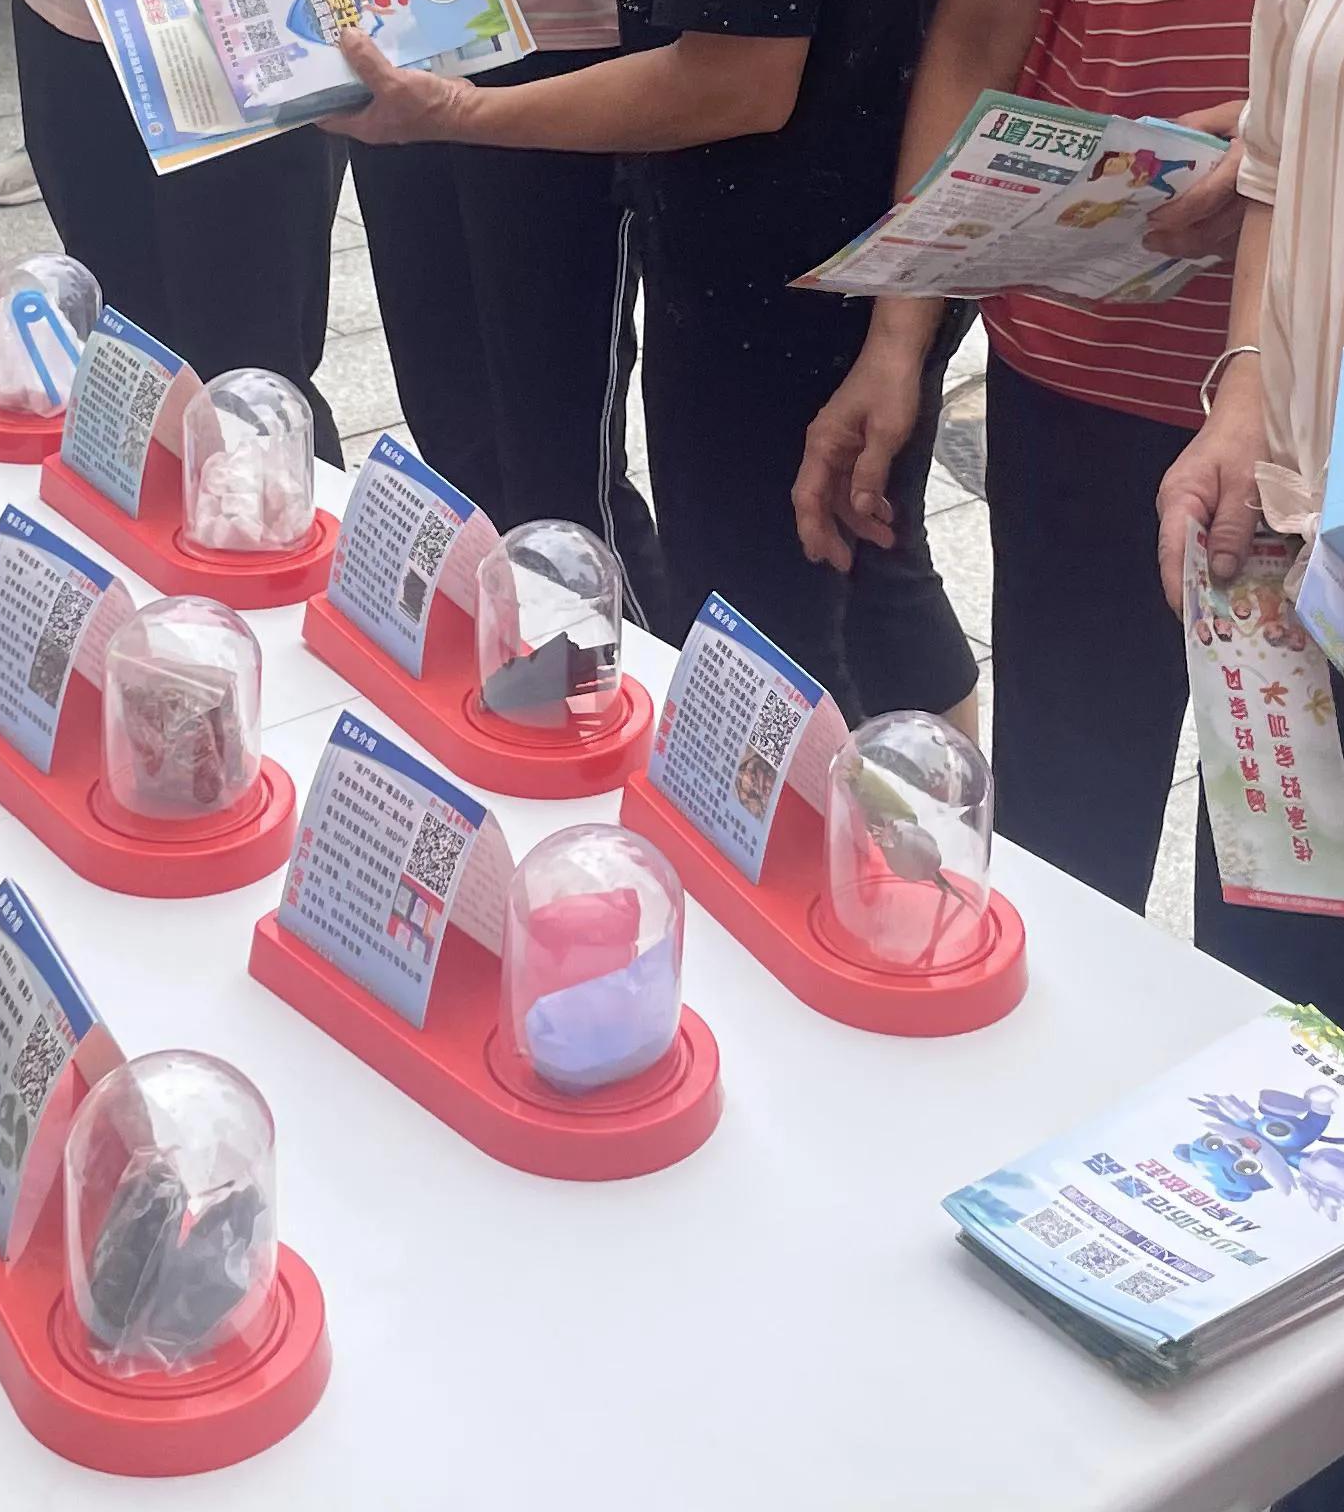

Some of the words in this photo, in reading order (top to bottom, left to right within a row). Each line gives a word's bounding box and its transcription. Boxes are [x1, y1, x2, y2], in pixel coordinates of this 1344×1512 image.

[340, 718, 377, 754] 毒品介绍
[1135, 1158, 1262, 1234] 从家庭做起
